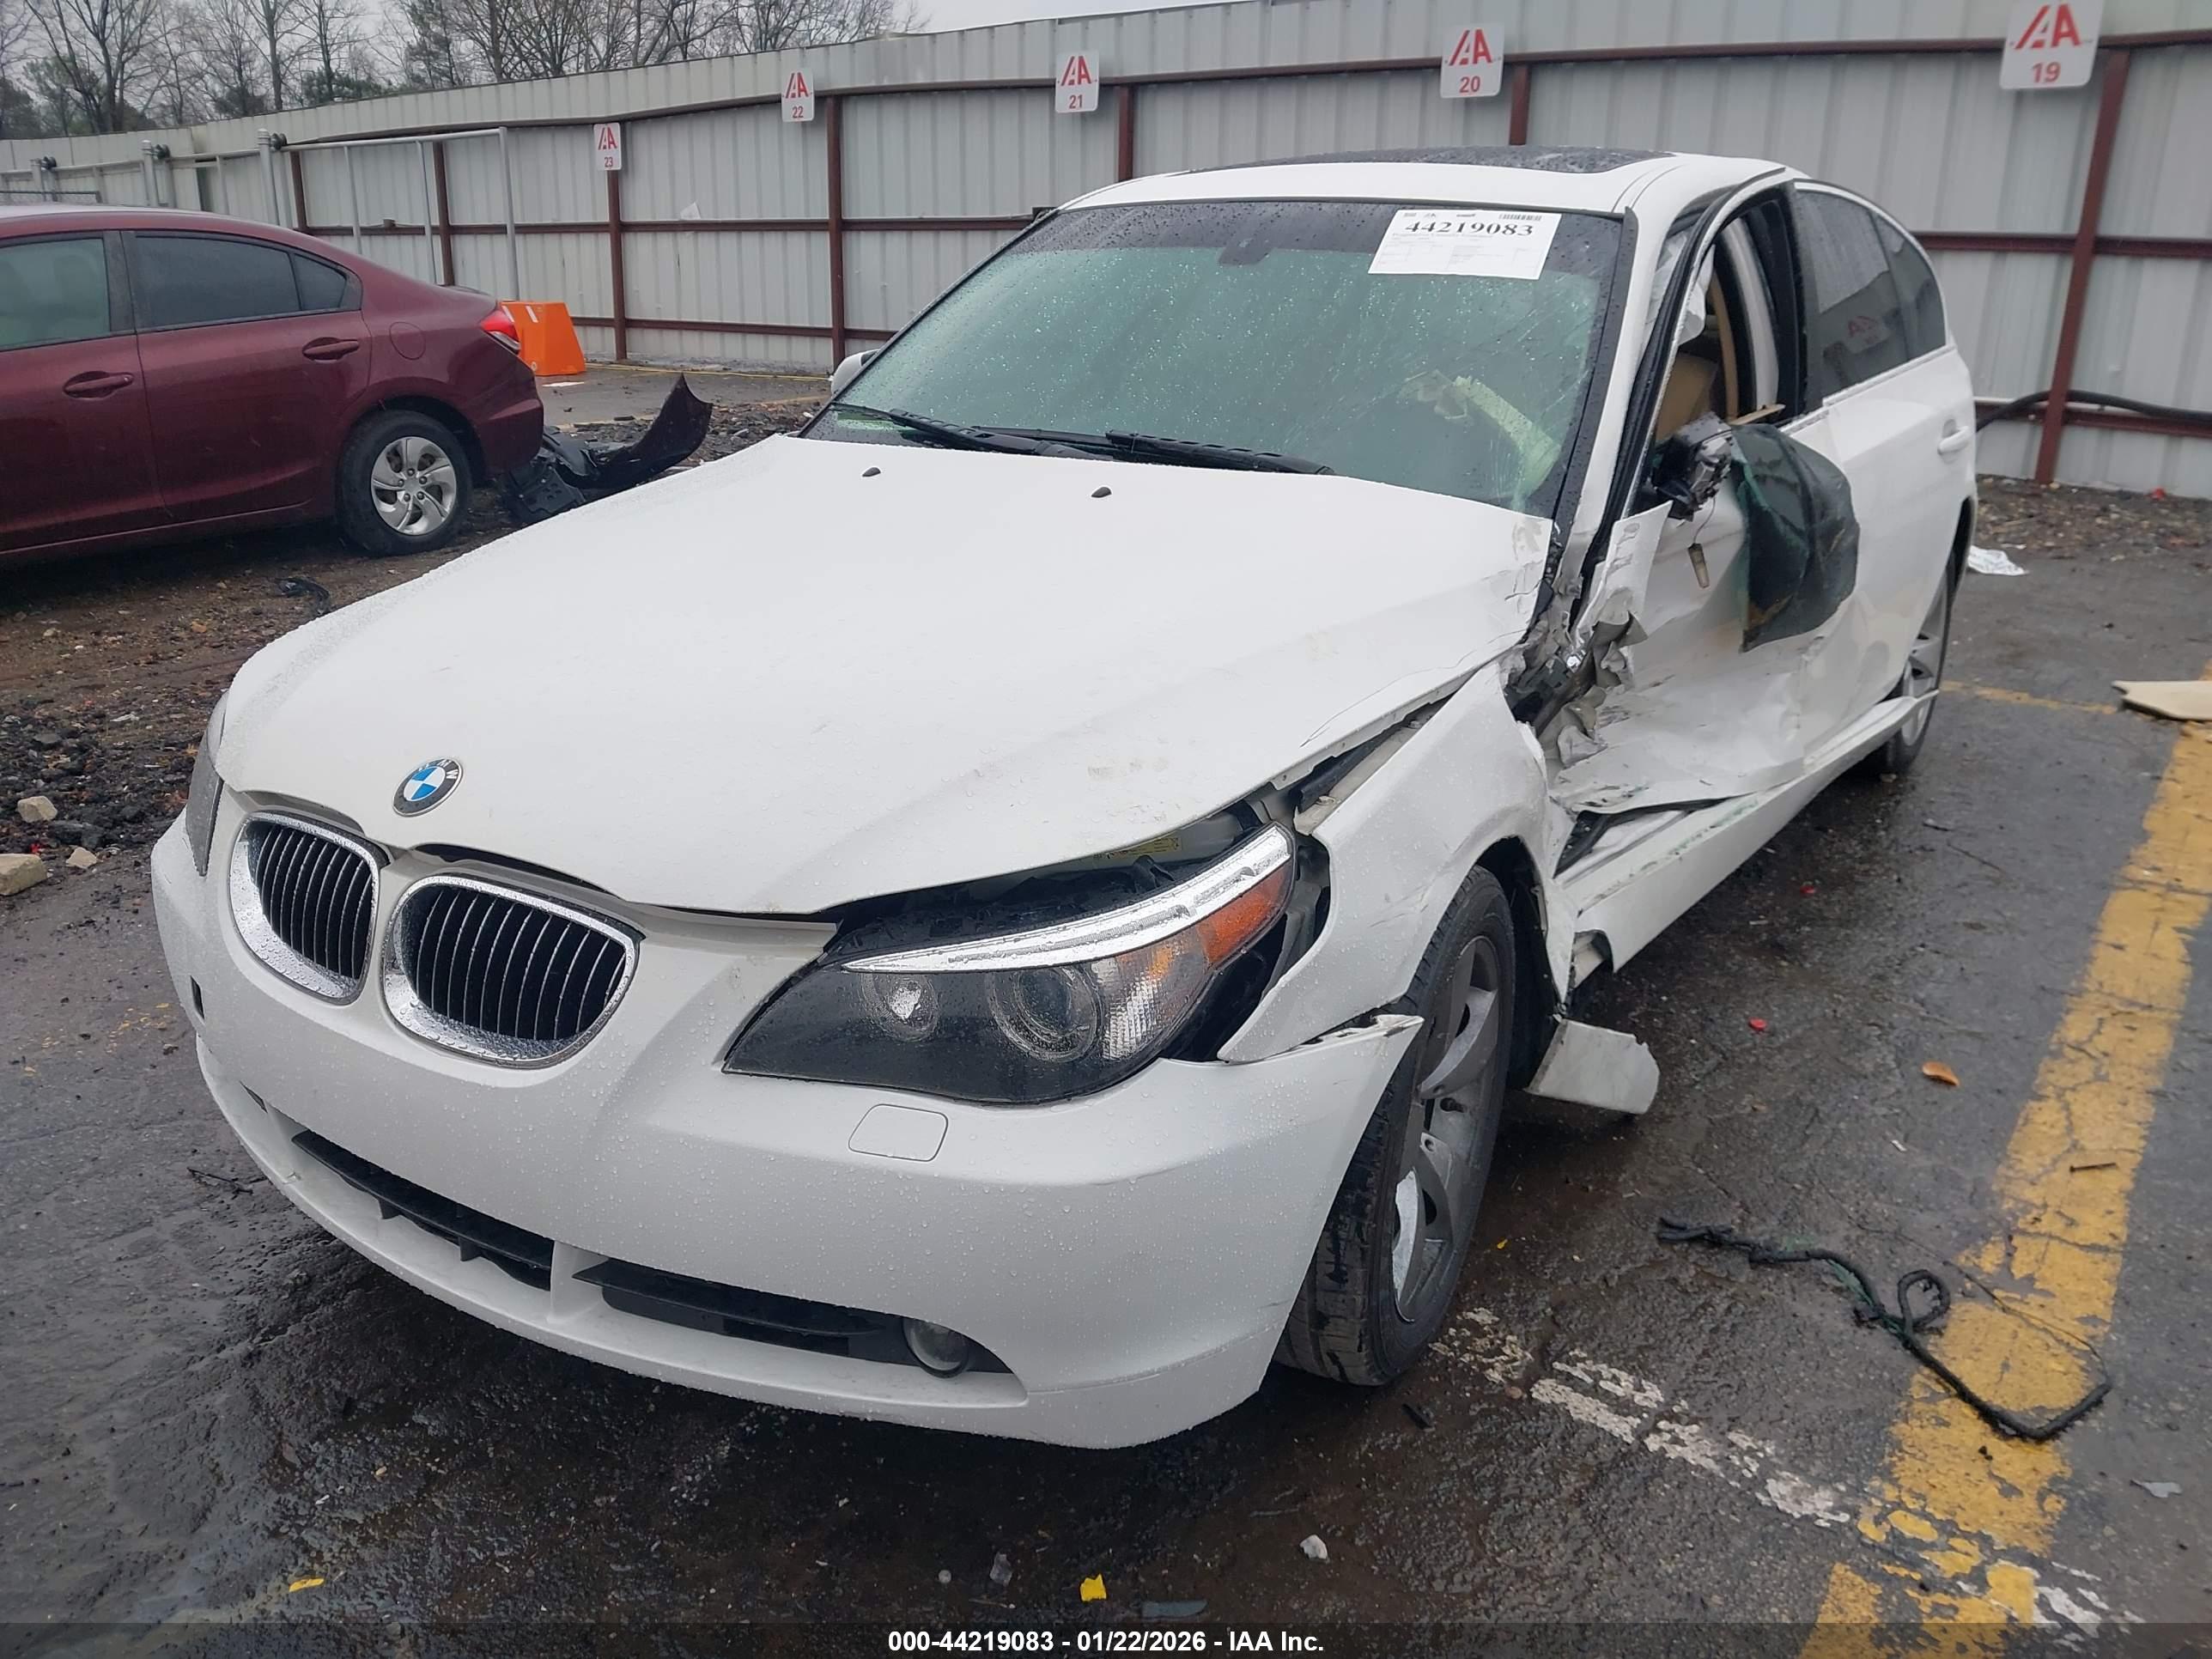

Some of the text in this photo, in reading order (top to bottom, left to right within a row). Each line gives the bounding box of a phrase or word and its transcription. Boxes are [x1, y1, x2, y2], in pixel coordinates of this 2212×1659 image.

[2032, 61, 2061, 83] 19
[1459, 76, 1480, 94] 20
[1069, 94, 1083, 110] 21
[792, 106, 804, 118] 22
[604, 156, 613, 167] 23
[1405, 221, 1534, 236] 44219083
